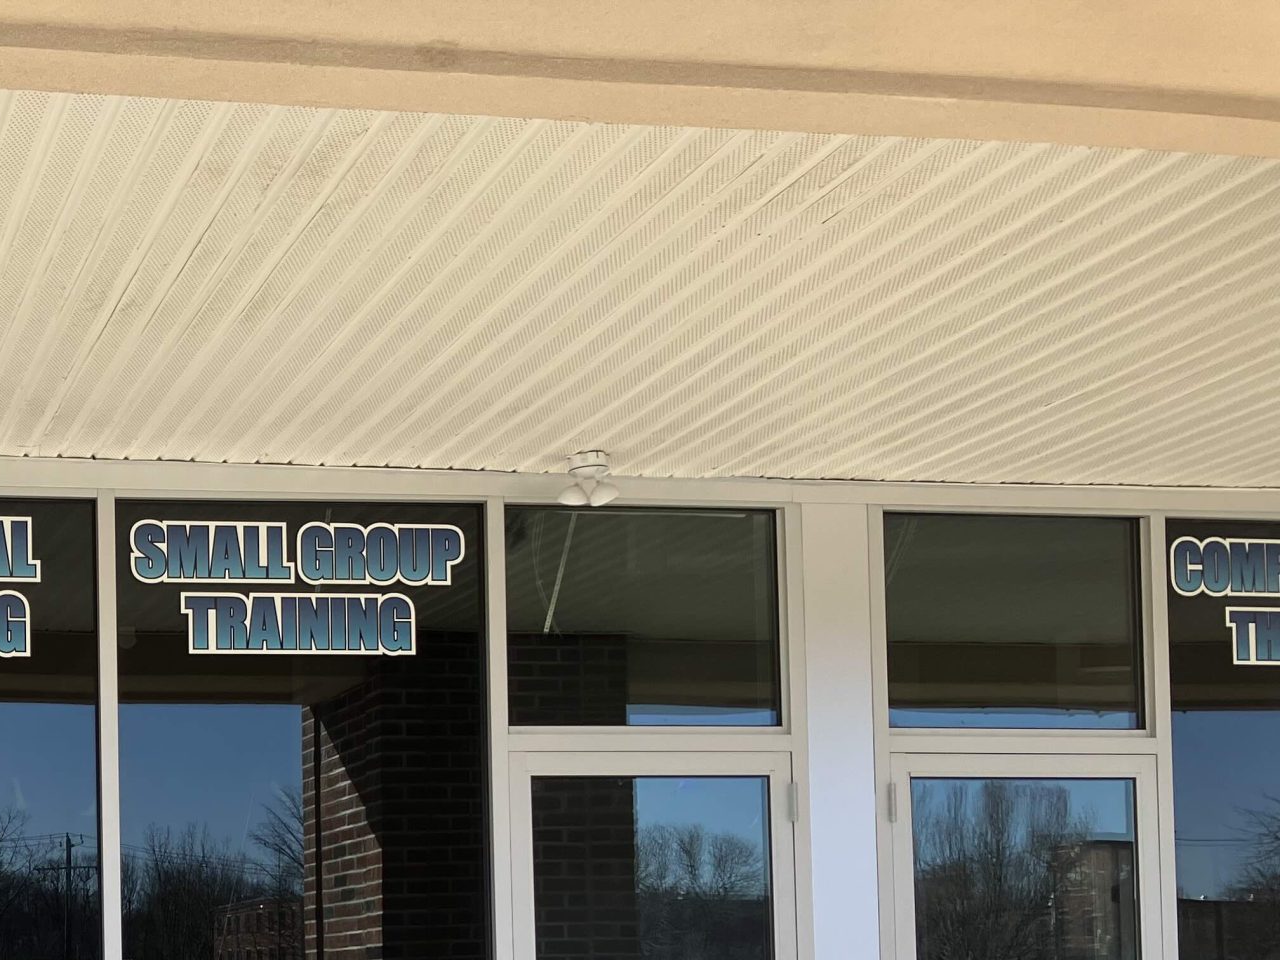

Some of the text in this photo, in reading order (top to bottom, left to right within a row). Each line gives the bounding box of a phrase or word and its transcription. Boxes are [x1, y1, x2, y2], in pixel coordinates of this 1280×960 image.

[130, 519, 465, 586] SMALL GROUP
[180, 592, 417, 656] TRAINING
